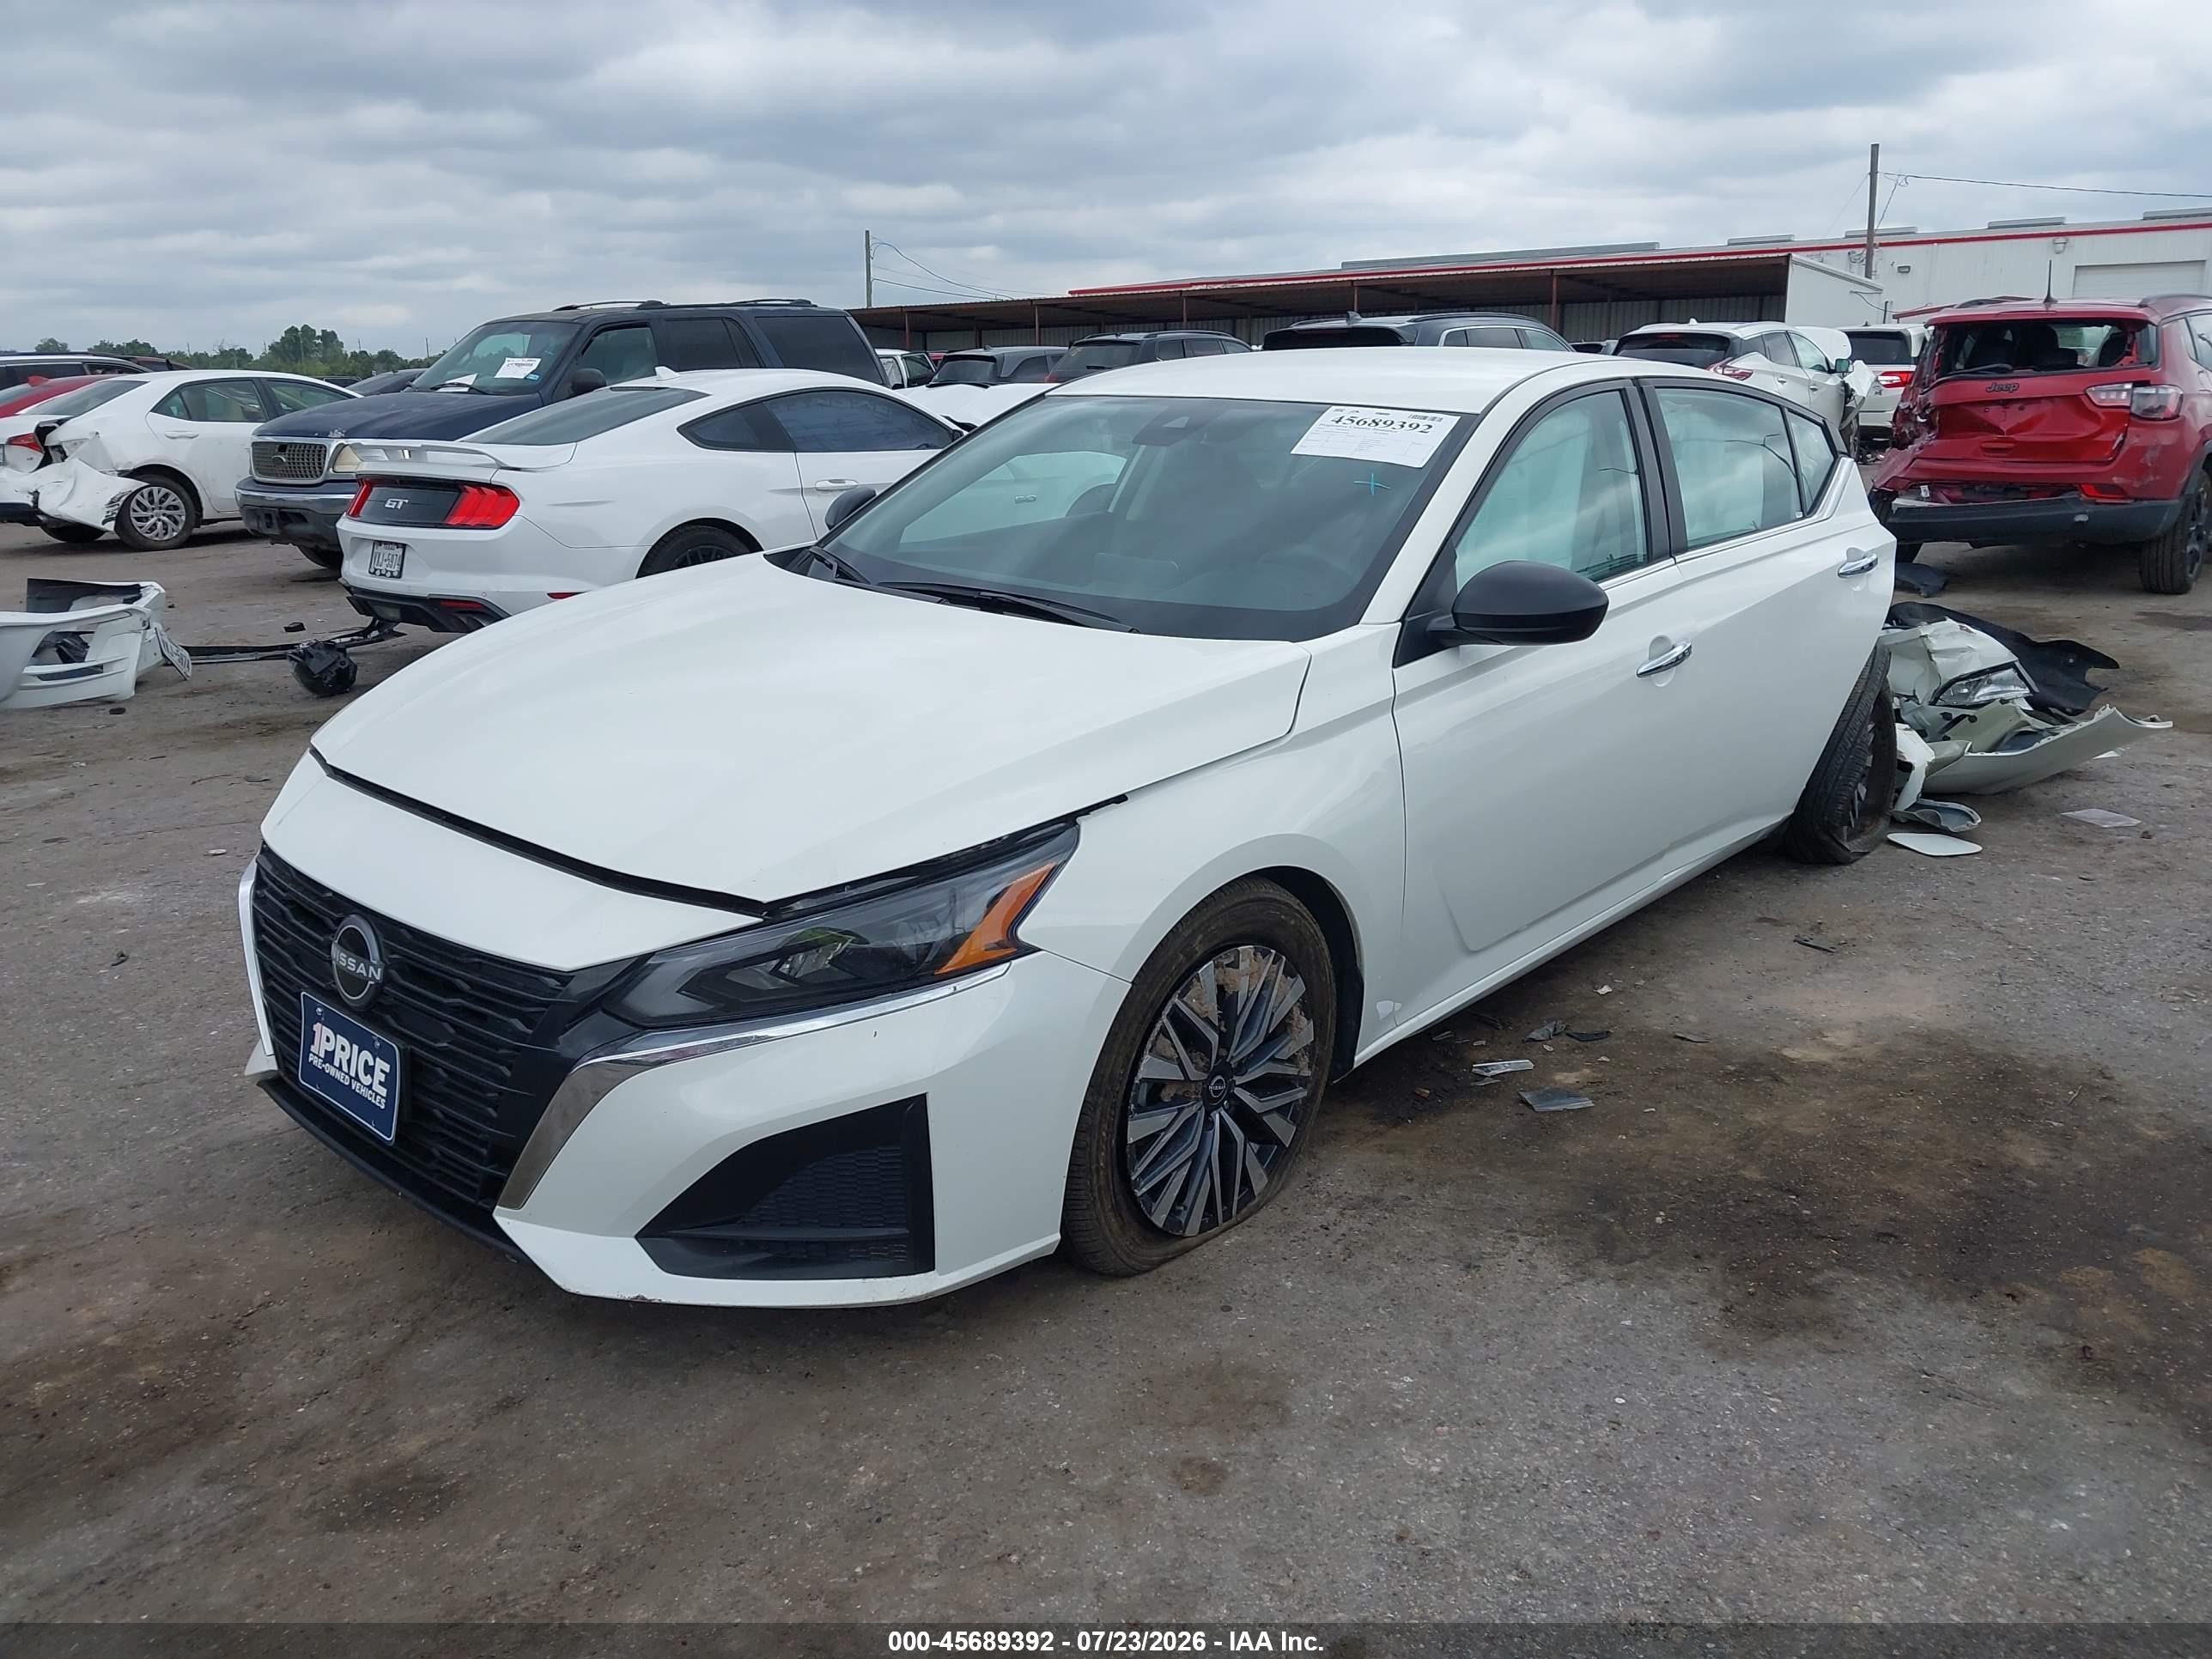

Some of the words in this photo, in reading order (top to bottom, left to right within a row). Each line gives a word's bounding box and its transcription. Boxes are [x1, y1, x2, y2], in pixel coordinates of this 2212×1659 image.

[1985, 382, 2020, 392] Jeep
[1331, 415, 1433, 434] 45689392
[385, 498, 409, 509] GT
[332, 945, 381, 981] NISSAN
[308, 1053, 349, 1085] PRE-OWNED
[350, 1079, 386, 1109] VEHICLES
